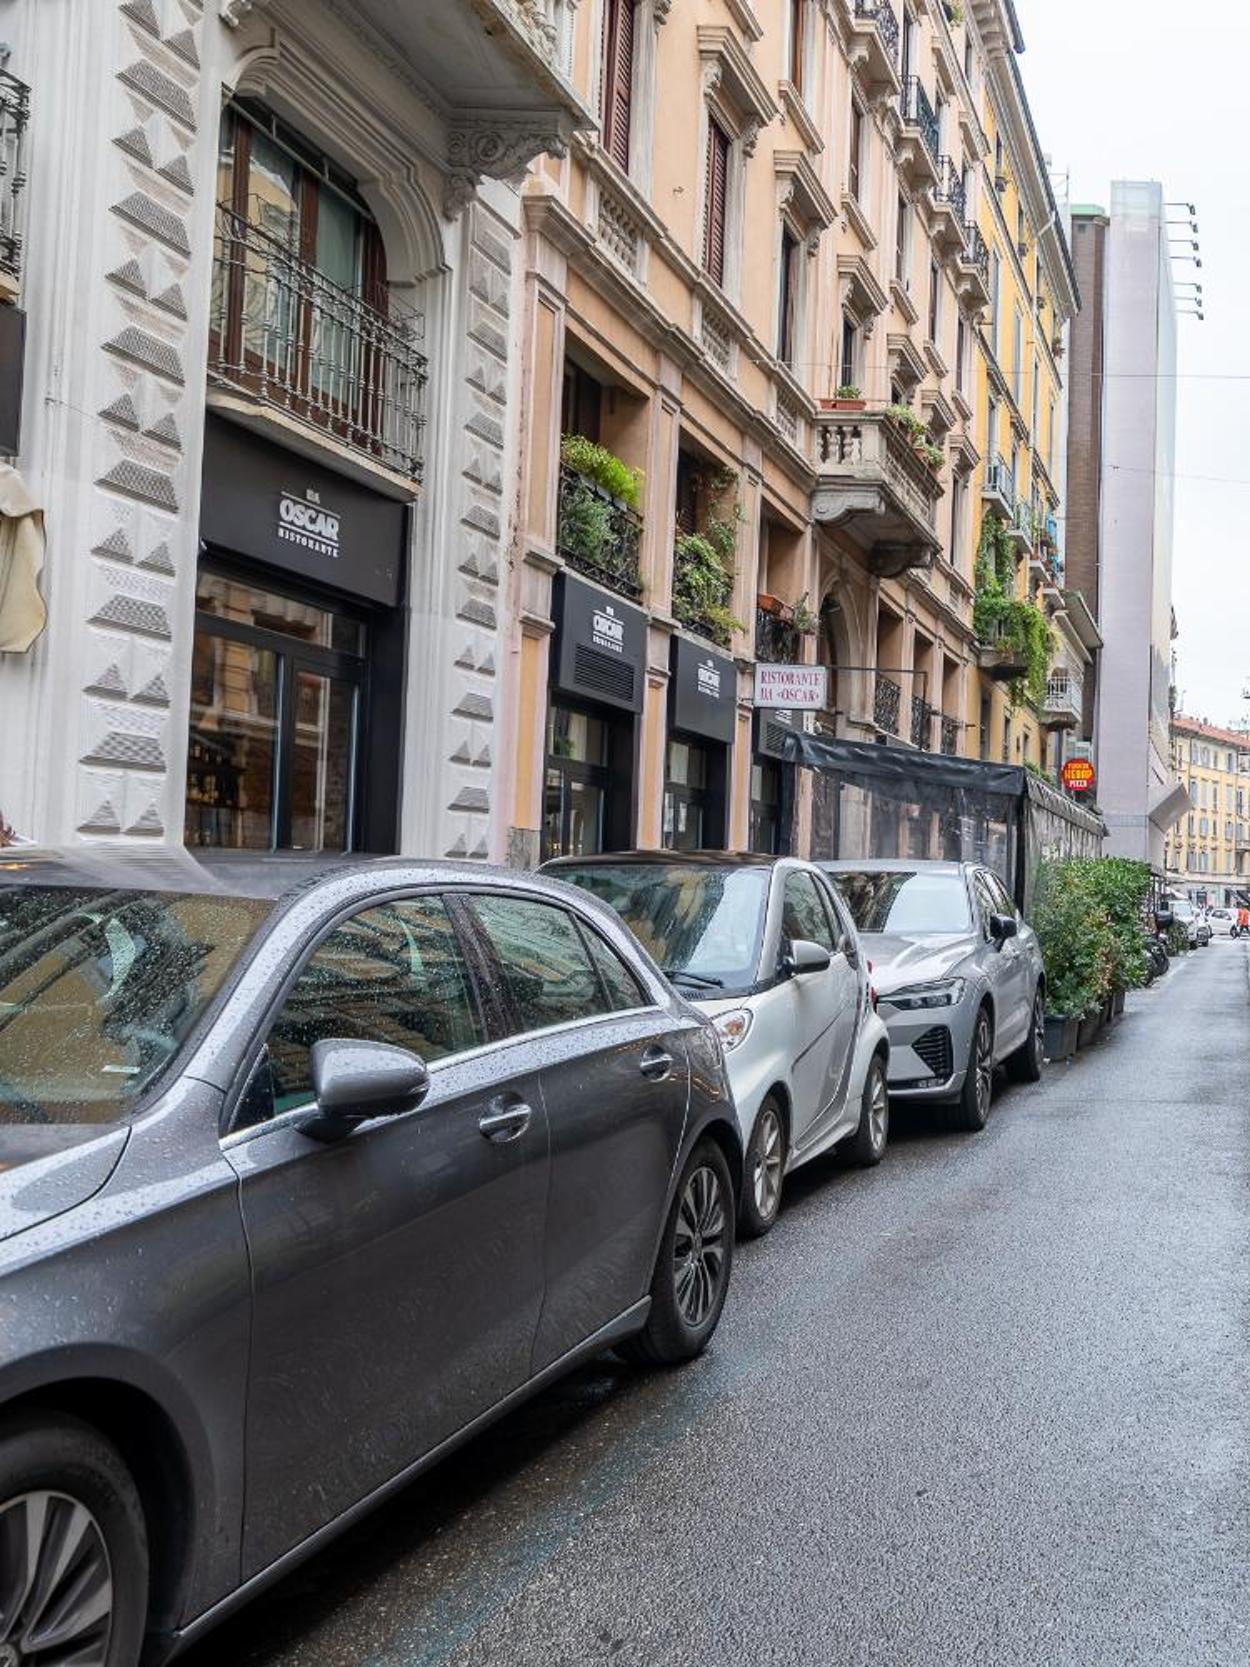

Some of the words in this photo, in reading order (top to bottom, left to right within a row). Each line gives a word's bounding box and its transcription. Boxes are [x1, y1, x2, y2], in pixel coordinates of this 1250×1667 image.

[280, 499, 339, 540] OSCAR
[278, 527, 339, 558] RISTORANTE
[761, 671, 821, 686] RISTORANTE
